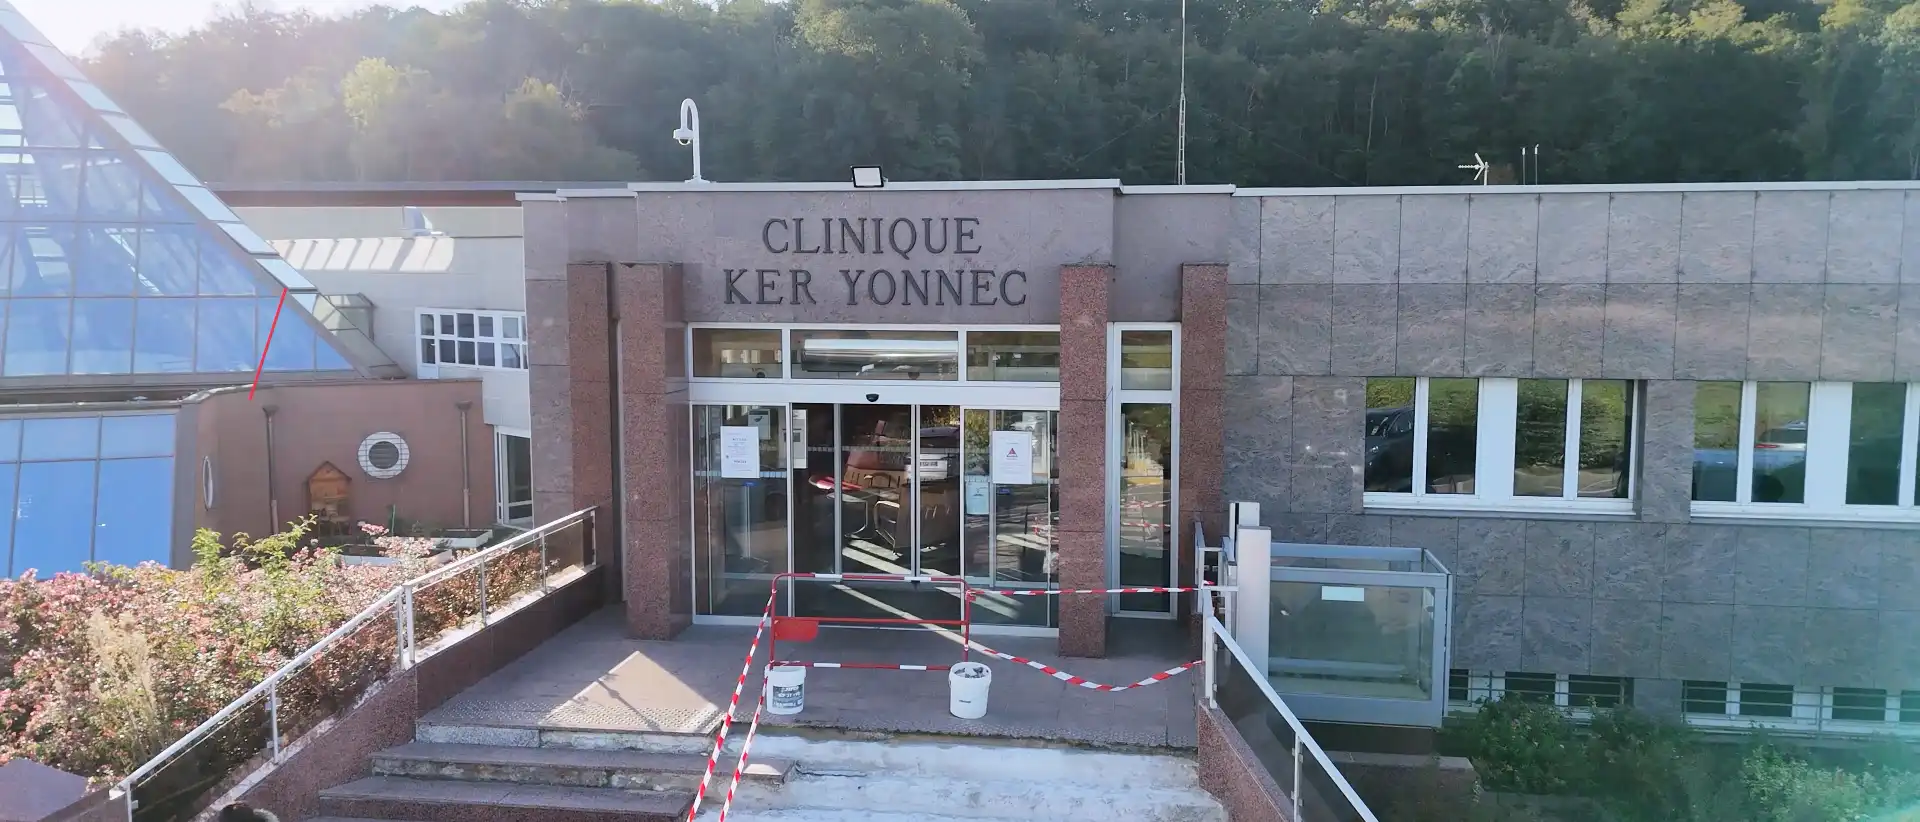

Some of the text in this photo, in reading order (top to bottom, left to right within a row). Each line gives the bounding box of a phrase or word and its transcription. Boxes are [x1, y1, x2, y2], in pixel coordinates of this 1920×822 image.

[762, 217, 982, 260] CLINIQUE
[723, 268, 1027, 306] KER YONNEC
